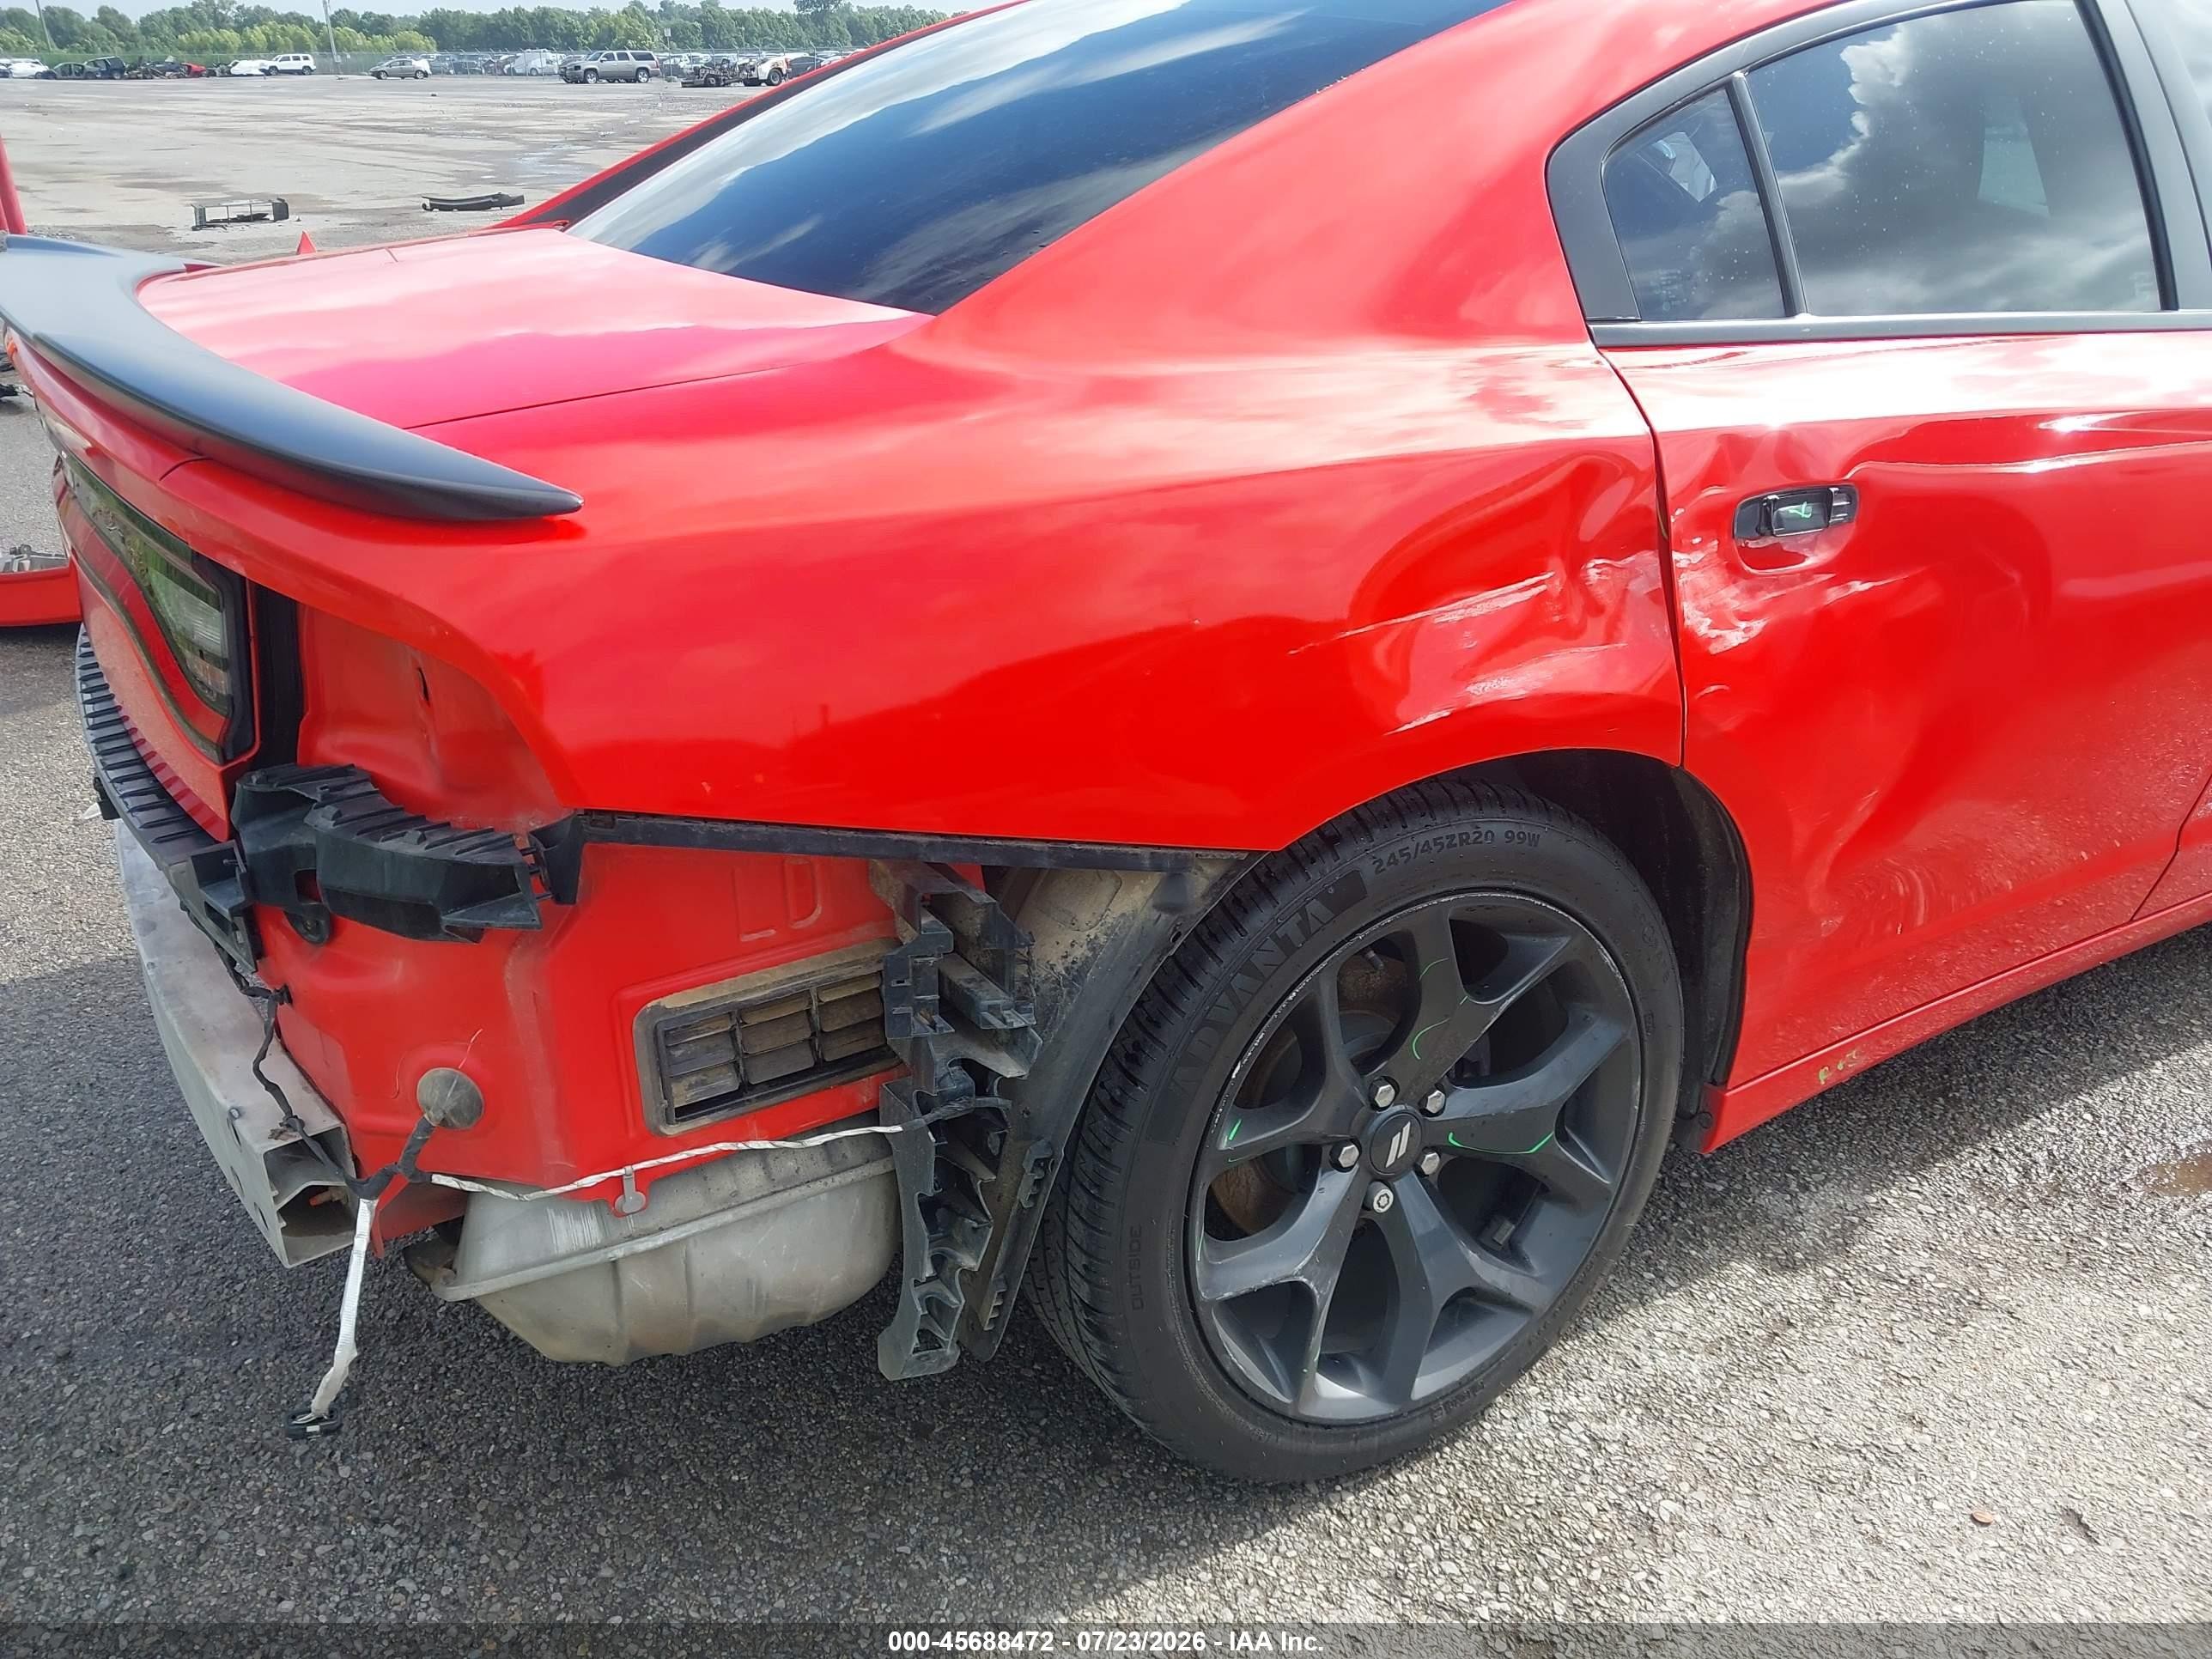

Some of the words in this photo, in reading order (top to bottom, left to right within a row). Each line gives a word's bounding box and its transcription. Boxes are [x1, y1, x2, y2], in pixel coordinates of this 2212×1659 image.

[1372, 830, 1495, 875] 245/45ZR20
[1504, 830, 1540, 848] 99W
[1170, 896, 1335, 1096] ADVANTA
[1126, 1223, 1144, 1312] OUTSIDE
